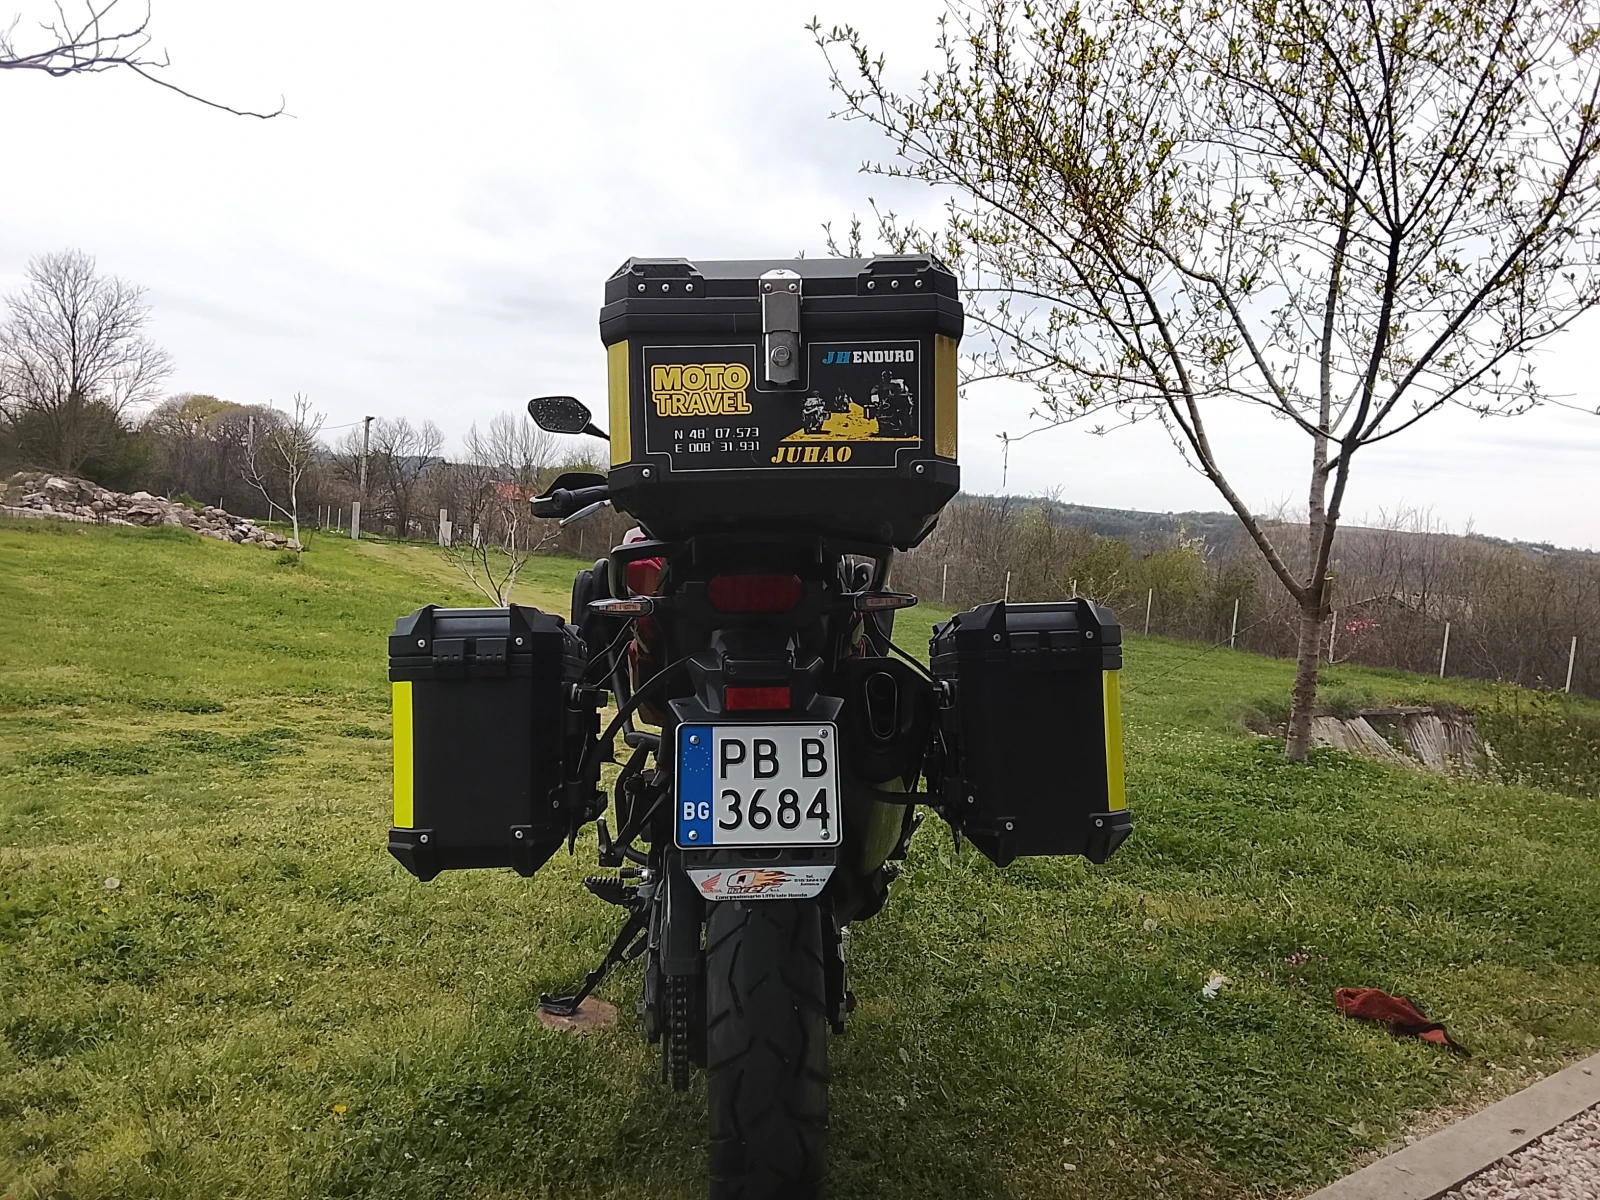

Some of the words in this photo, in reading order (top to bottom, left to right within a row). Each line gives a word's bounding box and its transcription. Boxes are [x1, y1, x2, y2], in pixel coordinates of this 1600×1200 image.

[652, 363, 751, 392] MOTO
[653, 391, 752, 416] TRAVEL
[674, 429, 683, 440] N
[715, 427, 760, 439] 07.573
[675, 443, 683, 453] E
[720, 441, 760, 452] 31.931
[771, 445, 853, 465] JUHAO
[719, 738, 780, 779] PB
[801, 738, 828, 779] B
[683, 801, 710, 821] BG
[718, 787, 830, 831] 3684
